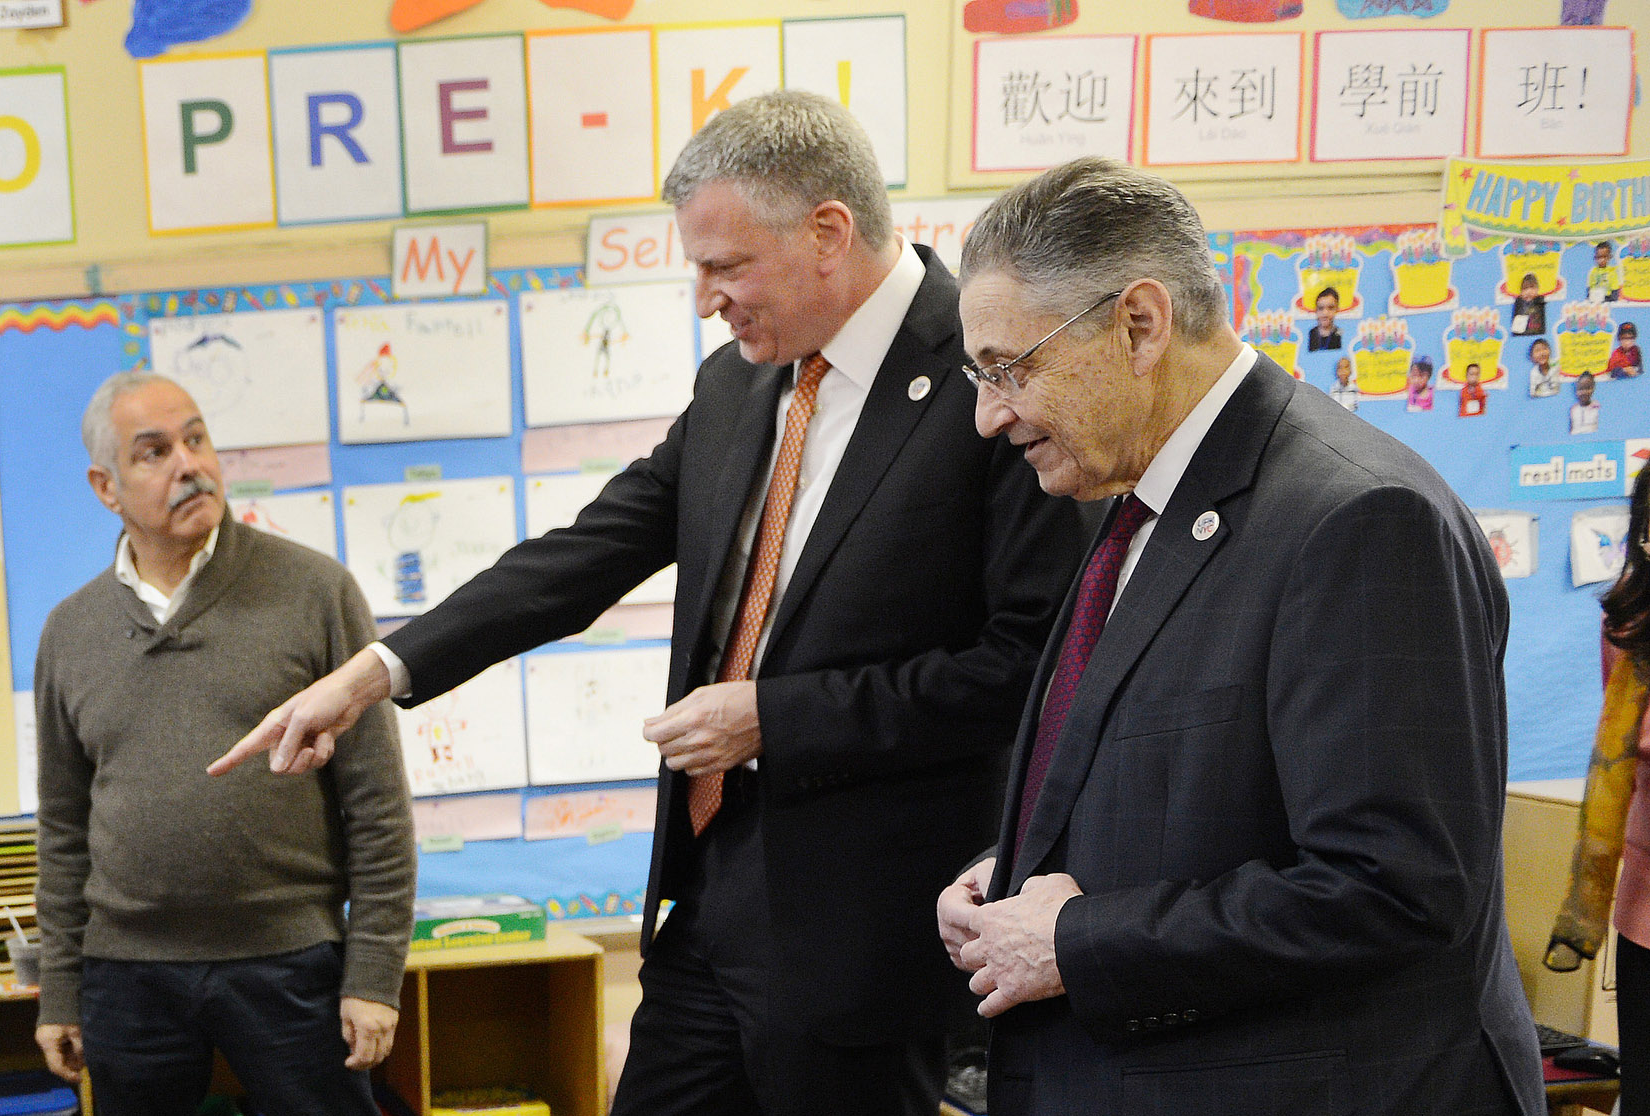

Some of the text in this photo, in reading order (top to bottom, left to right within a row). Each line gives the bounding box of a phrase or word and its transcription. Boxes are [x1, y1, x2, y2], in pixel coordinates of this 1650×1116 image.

[1465, 170, 1561, 223] HAPPY
[402, 221, 689, 294] My Sel
[1523, 459, 1614, 479] rest mats
